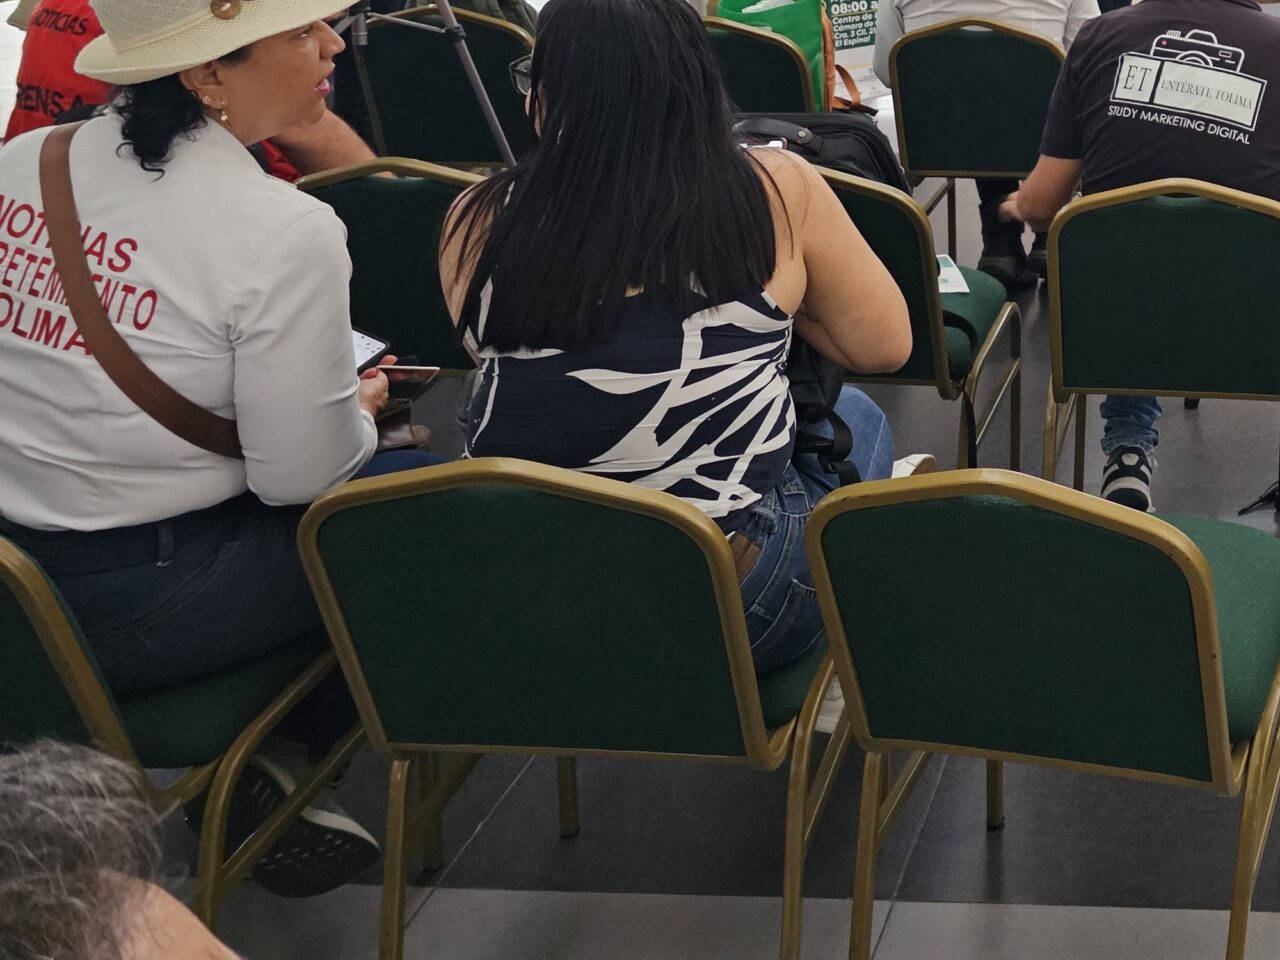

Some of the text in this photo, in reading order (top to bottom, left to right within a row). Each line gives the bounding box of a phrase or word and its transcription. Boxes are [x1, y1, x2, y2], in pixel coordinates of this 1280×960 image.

[831, 0, 867, 14] 08:00
[832, 14, 860, 25] Centro
[862, 13, 873, 21] de
[833, 22, 863, 32] Cámara
[835, 35, 870, 47] El Espinal
[1123, 65, 1152, 92] ET
[1214, 90, 1253, 110] TOLIMA
[1108, 105, 1251, 145] STUDY MARKETING DIGITAL
